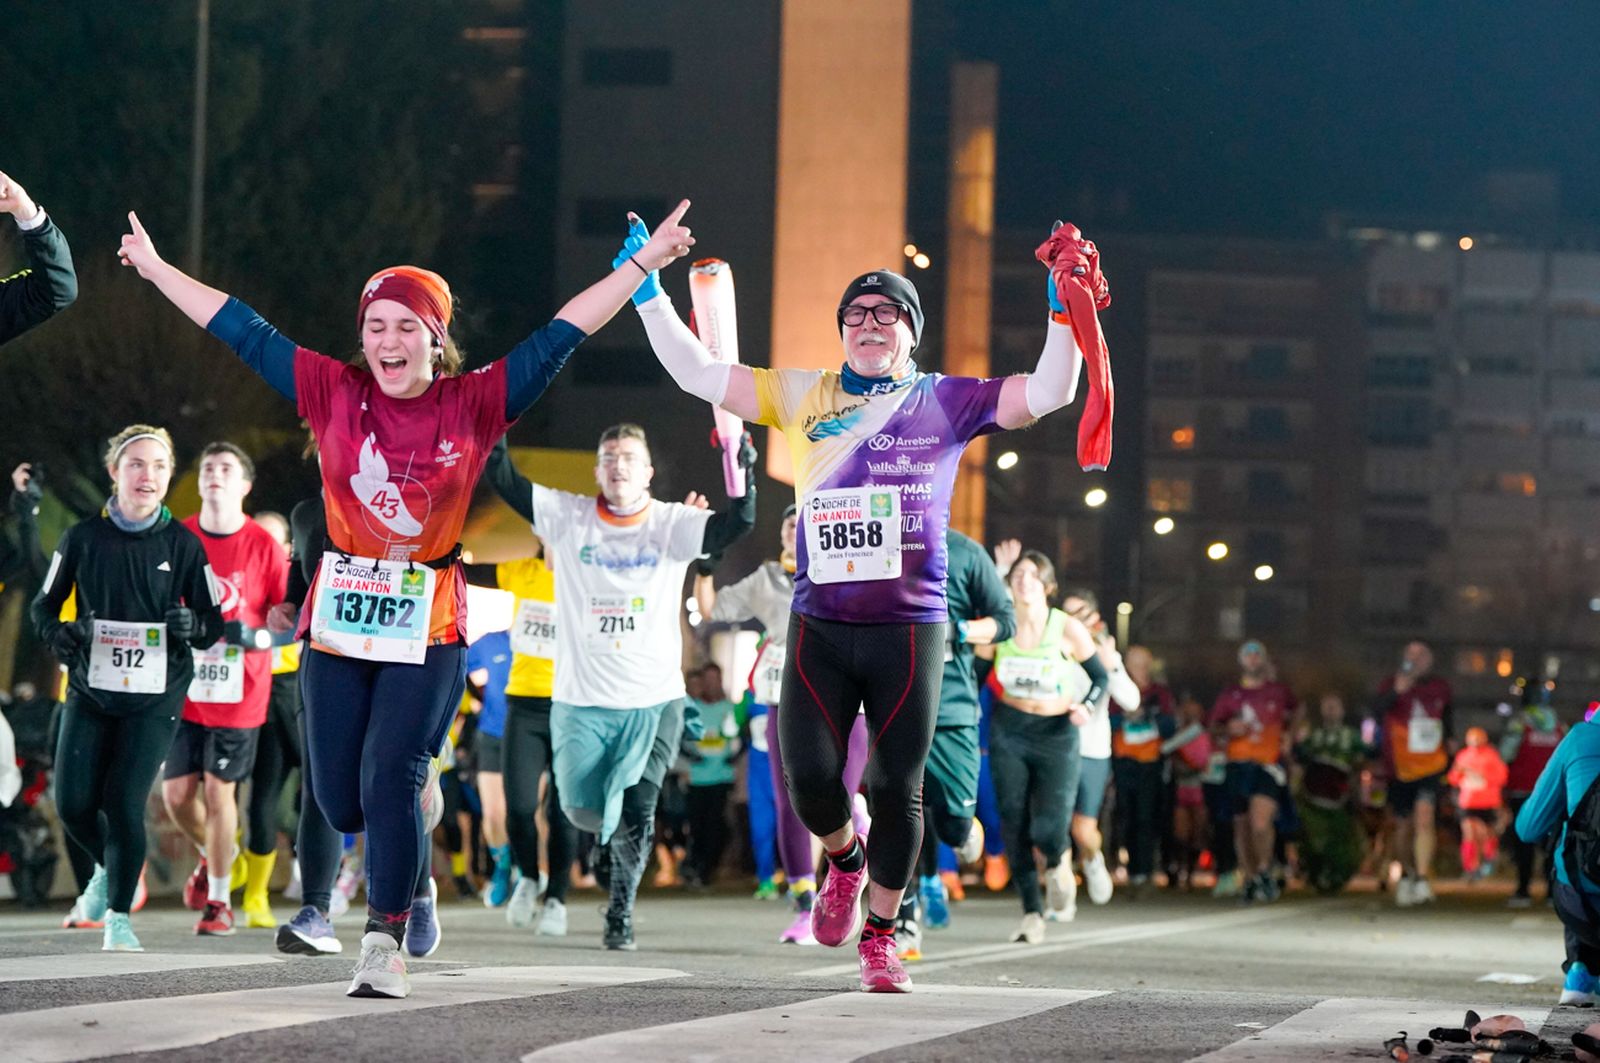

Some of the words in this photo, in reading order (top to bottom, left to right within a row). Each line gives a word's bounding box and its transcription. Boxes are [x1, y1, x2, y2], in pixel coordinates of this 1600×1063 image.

[896, 436, 940, 446] Arrebola
[370, 490, 400, 519] 43
[821, 499, 848, 510] NOCHE
[849, 498, 861, 508] DE
[812, 512, 828, 523] SAN
[818, 520, 883, 551] 5858
[346, 567, 376, 581] NOCHE
[378, 572, 392, 582] DE
[332, 577, 353, 589] SAN
[333, 592, 416, 628] 13762
[600, 616, 635, 633] 2714
[112, 647, 145, 668] 512
